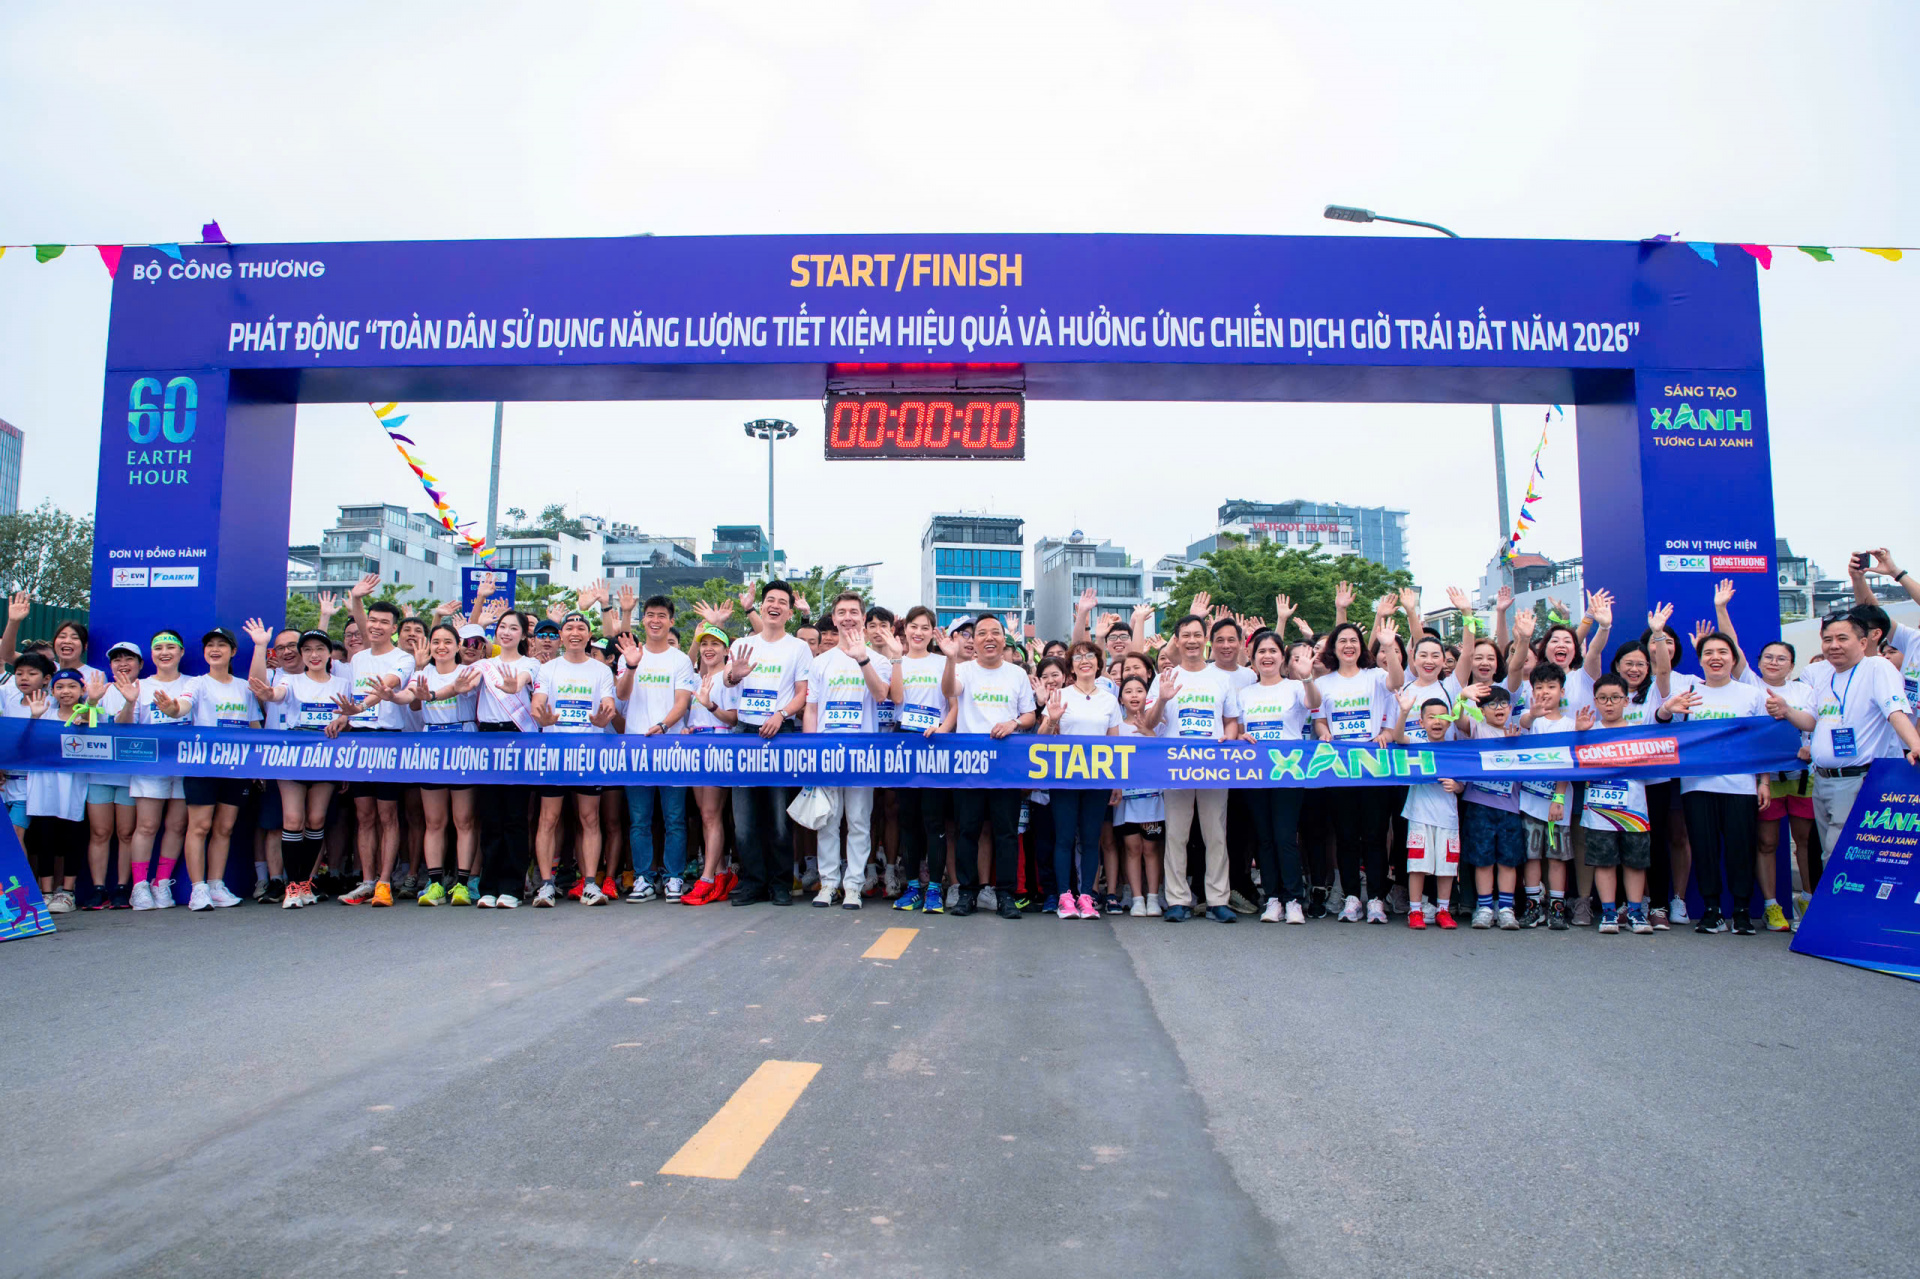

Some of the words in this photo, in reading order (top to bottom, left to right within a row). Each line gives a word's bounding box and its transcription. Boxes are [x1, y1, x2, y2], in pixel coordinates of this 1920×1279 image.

[133, 260, 161, 283] BỘ
[168, 259, 232, 279] CÔNG
[239, 259, 324, 278] THƯƠNG
[791, 254, 1022, 291] START/FINISH
[229, 314, 291, 351] PHÁT
[294, 314, 359, 358] ĐỘNG
[446, 312, 496, 348] DÂN
[501, 308, 534, 348] SỬ
[538, 318, 603, 355] DỤNG
[610, 310, 679, 347] NĂNG
[685, 312, 766, 354] LƯỢNG
[773, 302, 825, 346] TIẾT
[831, 308, 891, 354] KIỆM
[898, 308, 954, 353] HIỆU
[961, 305, 1013, 352] QUẢ
[1018, 308, 1053, 345] VÀ
[1059, 305, 1146, 346] HƯỞNG
[1153, 309, 1204, 347] ỨNG
[1211, 303, 1283, 347] CHIẾN
[1290, 318, 1345, 356] DỊCH
[1351, 311, 1391, 349] GIỜ
[1395, 312, 1452, 349] TRÁI
[1458, 306, 1506, 350] ĐẤT
[1512, 314, 1568, 350] NĂM
[1664, 384, 1704, 398] SÁNG
[1707, 386, 1737, 400] TẠO
[128, 376, 198, 444] 60
[1650, 403, 1752, 431] XANH
[831, 402, 1020, 447] 00:00:00
[1653, 437, 1695, 446] TƯƠNG
[1698, 438, 1716, 446] LAI
[1720, 438, 1753, 447] XANH
[127, 450, 192, 465] EARTH
[129, 470, 189, 485] HOUR
[1253, 522, 1300, 532] VIETFOOT
[1305, 523, 1340, 532] TRAVEL
[1666, 538, 1689, 549] ĐƠN
[1692, 540, 1702, 551] VỊ
[1704, 538, 1731, 551] THỰC
[1734, 539, 1757, 552] HIỆN
[109, 548, 131, 558] ĐƠN
[134, 550, 144, 560] VỊ
[146, 546, 176, 558] ĐỒNG
[178, 547, 206, 557] HÀNH
[747, 698, 770, 707] 3.663
[562, 710, 586, 718] 3.259
[828, 711, 859, 719] 28.719
[904, 714, 934, 724] 3.333
[1182, 718, 1212, 728] 28.403
[1339, 720, 1366, 730] 3.668
[177, 734, 206, 764] GIẢI
[210, 743, 249, 770] CHẠY
[301, 743, 333, 767] DÂN
[335, 740, 358, 768] SỬ
[357, 747, 396, 773] DỤNG
[400, 743, 439, 770] NĂNG
[443, 746, 488, 775] LƯỢNG
[493, 741, 521, 770] TIẾT
[524, 744, 559, 776] KIỆM
[564, 744, 595, 776] HIỆU
[600, 741, 626, 774] QUẢ
[631, 744, 648, 771] VÀ
[653, 741, 700, 772] HƯỞNG
[705, 744, 733, 772] ỨNG
[738, 742, 779, 772] CHIẾN
[784, 749, 816, 777] DỊCH
[822, 744, 845, 772] GIỜ
[849, 744, 880, 772] TRÁI
[885, 741, 912, 773] ĐẤT
[916, 745, 949, 773] NĂM
[1168, 745, 1215, 760] SÁNG
[1220, 749, 1256, 763] TẠO
[1269, 742, 1436, 780] XANH
[1029, 744, 1136, 780] START
[1168, 767, 1232, 780] TƯƠNG
[1236, 769, 1262, 780] LAI
[1590, 788, 1624, 800] 21.657
[1880, 792, 1906, 803] SÁNG
[1908, 794, 1920, 806] TẠ
[1856, 833, 1881, 843] TƯƠNG
[1881, 836, 1895, 844] LAI
[1894, 836, 1918, 846] XANH
